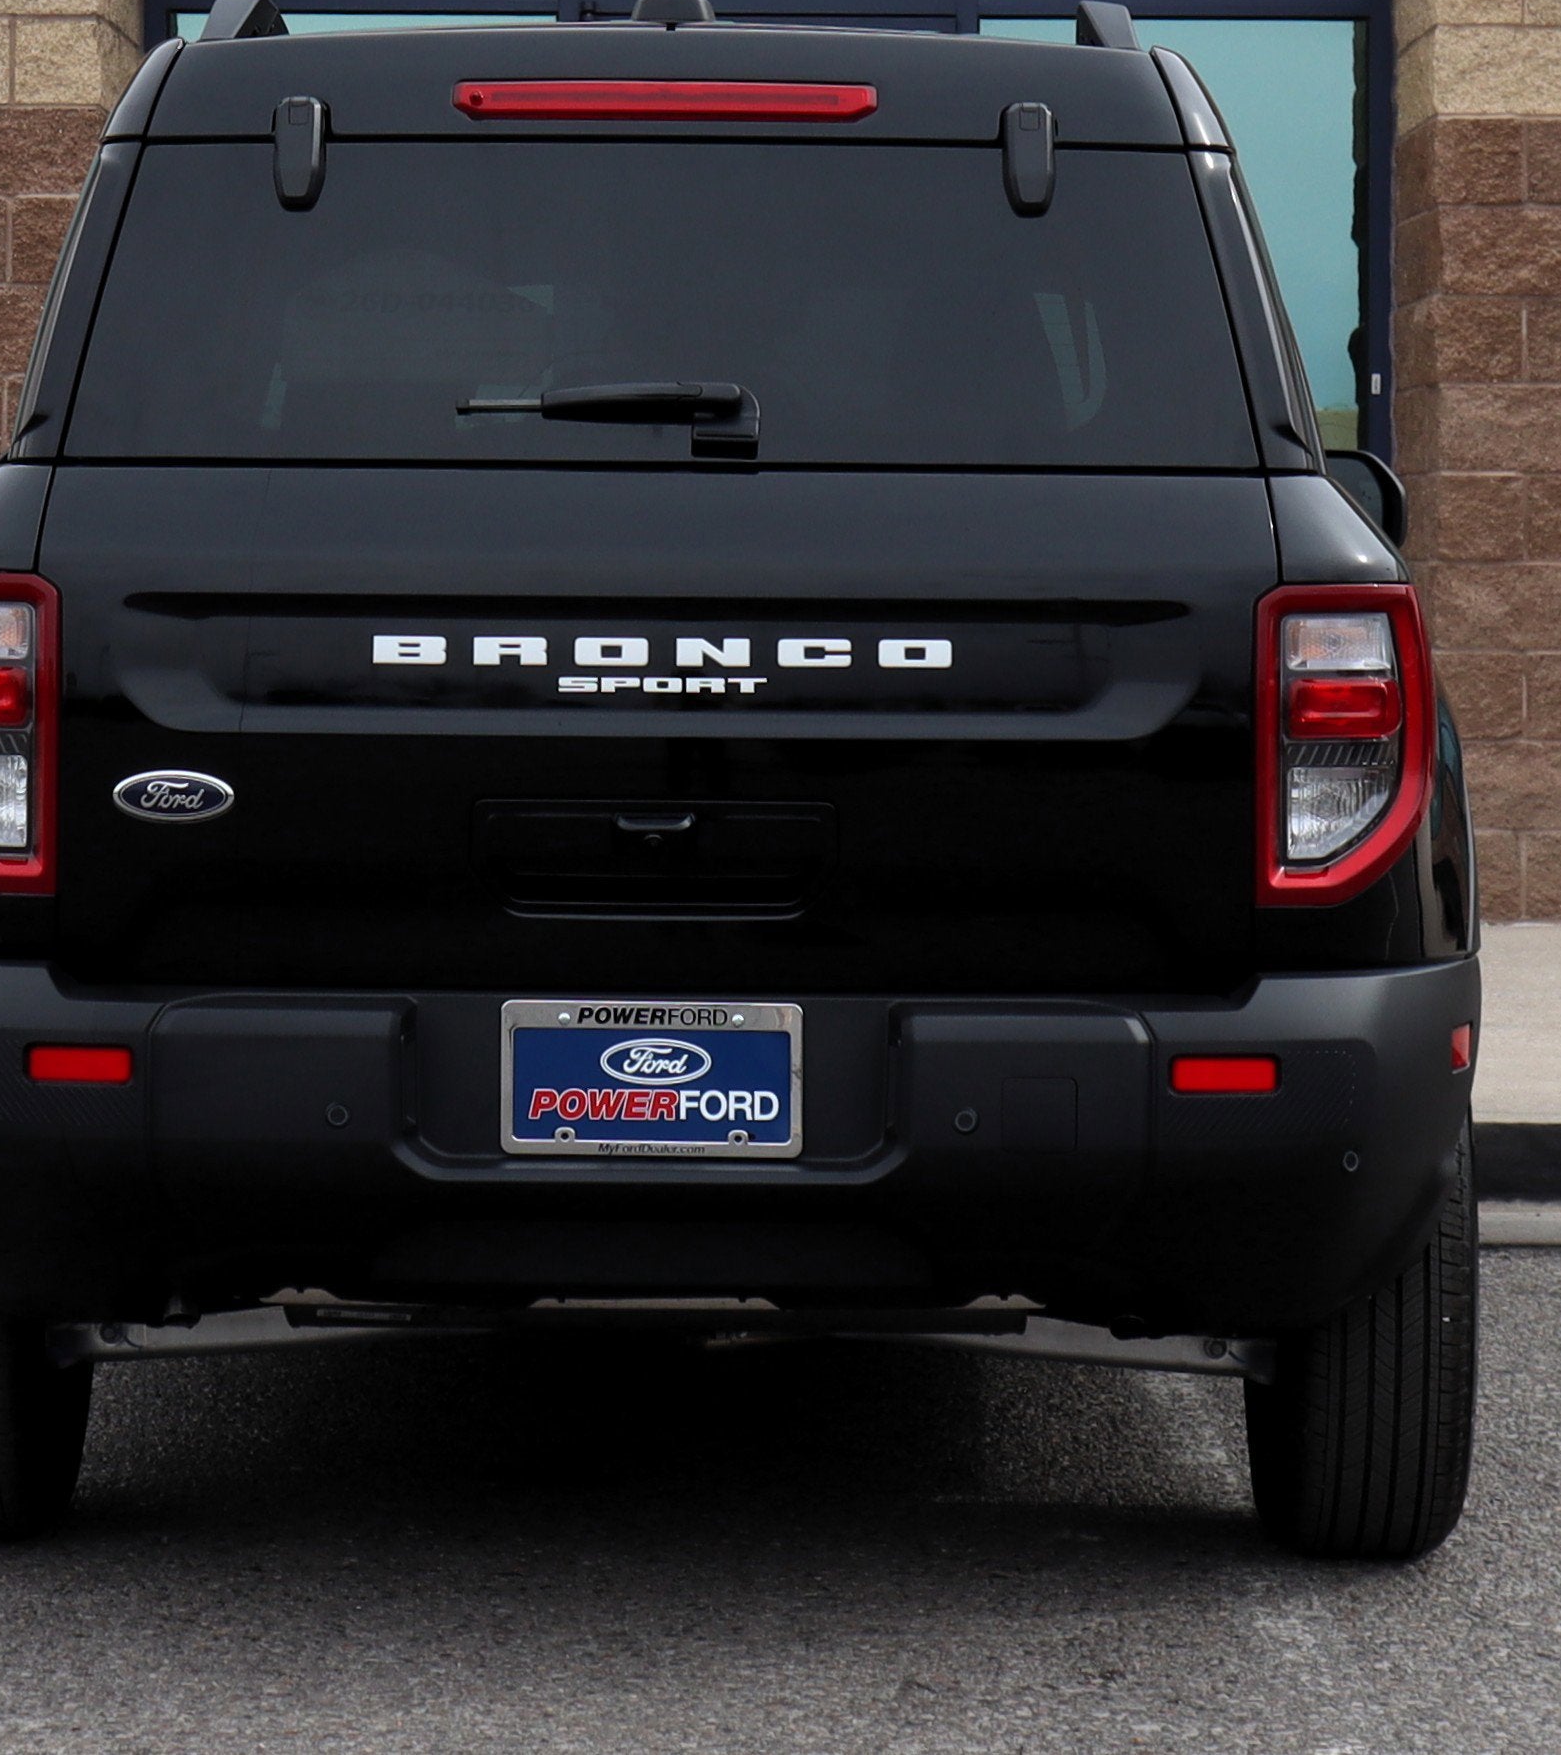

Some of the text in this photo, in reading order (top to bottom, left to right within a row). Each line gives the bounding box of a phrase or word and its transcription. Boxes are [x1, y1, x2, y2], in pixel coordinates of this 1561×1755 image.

[372, 635, 952, 668] BRONCO
[558, 677, 767, 693] SPORT
[140, 780, 205, 809] Ford
[623, 1046, 688, 1075] Ford
